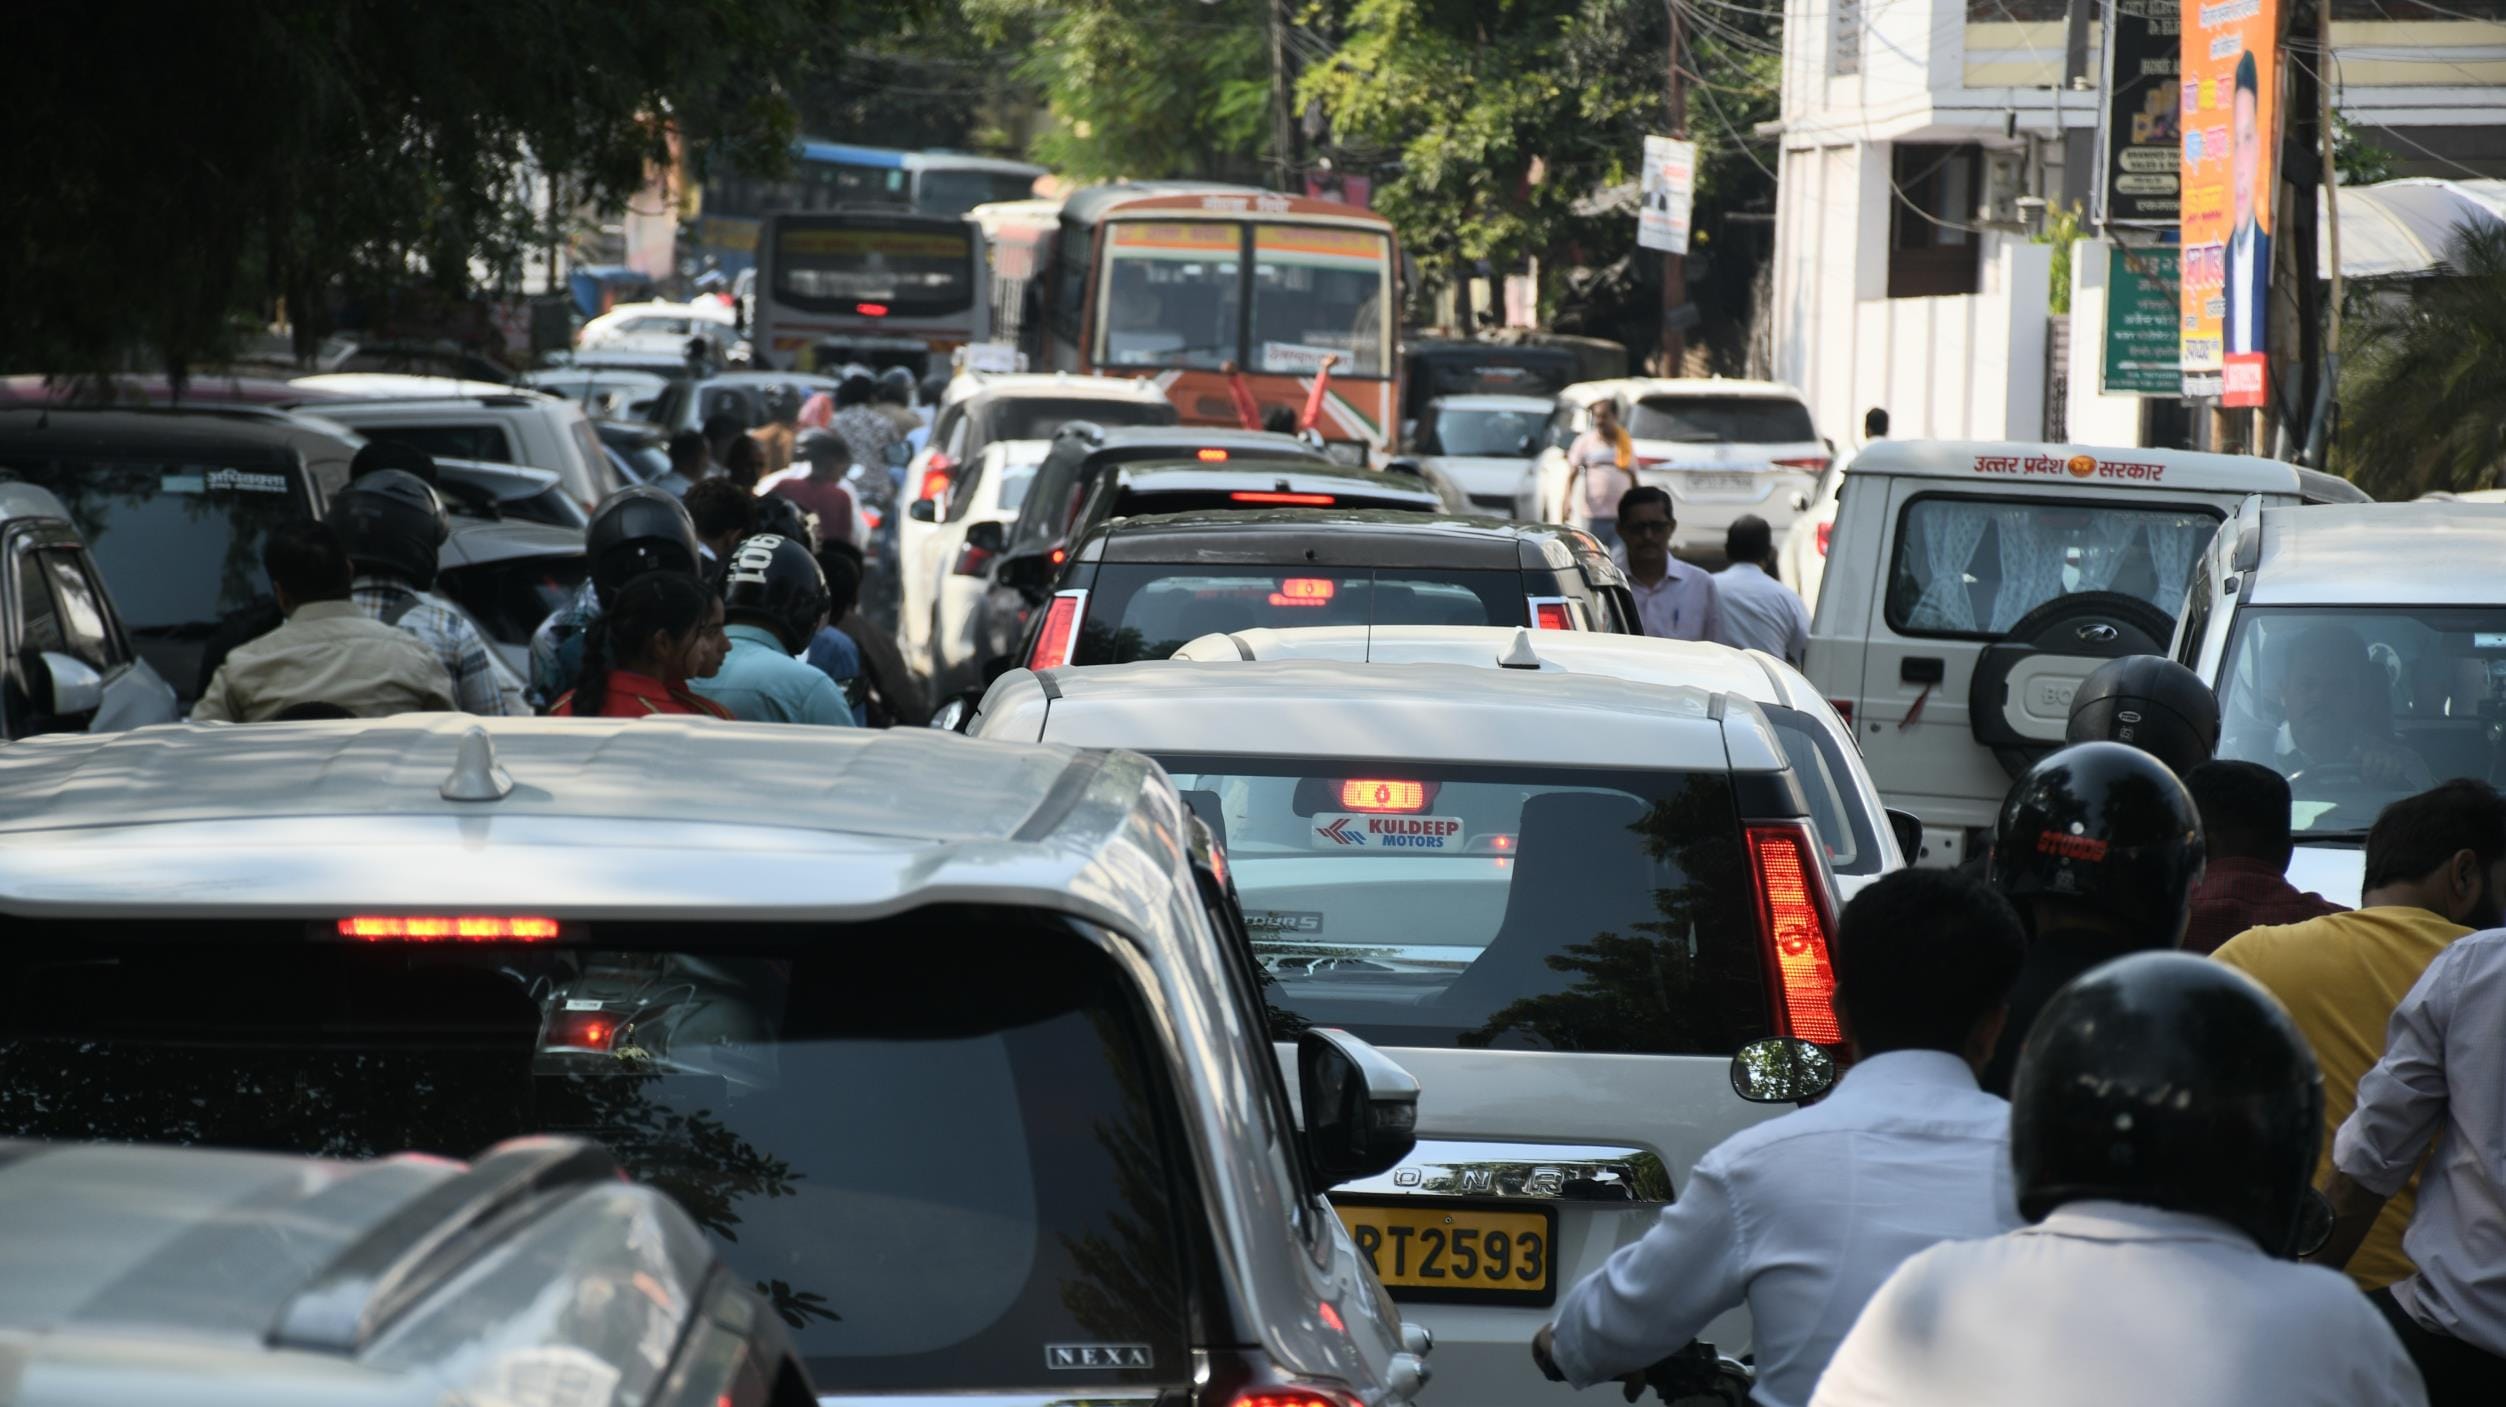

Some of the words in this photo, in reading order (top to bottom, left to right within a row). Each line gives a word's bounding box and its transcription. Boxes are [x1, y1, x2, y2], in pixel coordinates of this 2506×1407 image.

[1974, 456, 2020, 473] उत्तर
[2023, 454, 2065, 475] प्रदेश
[2099, 460, 2166, 481] सरकार
[1369, 819, 1459, 836] KULDEEP
[1382, 835, 1444, 847] MOTORS
[1355, 1225, 1544, 1282] RT2593
[1056, 1349, 1146, 1365] NEXA
